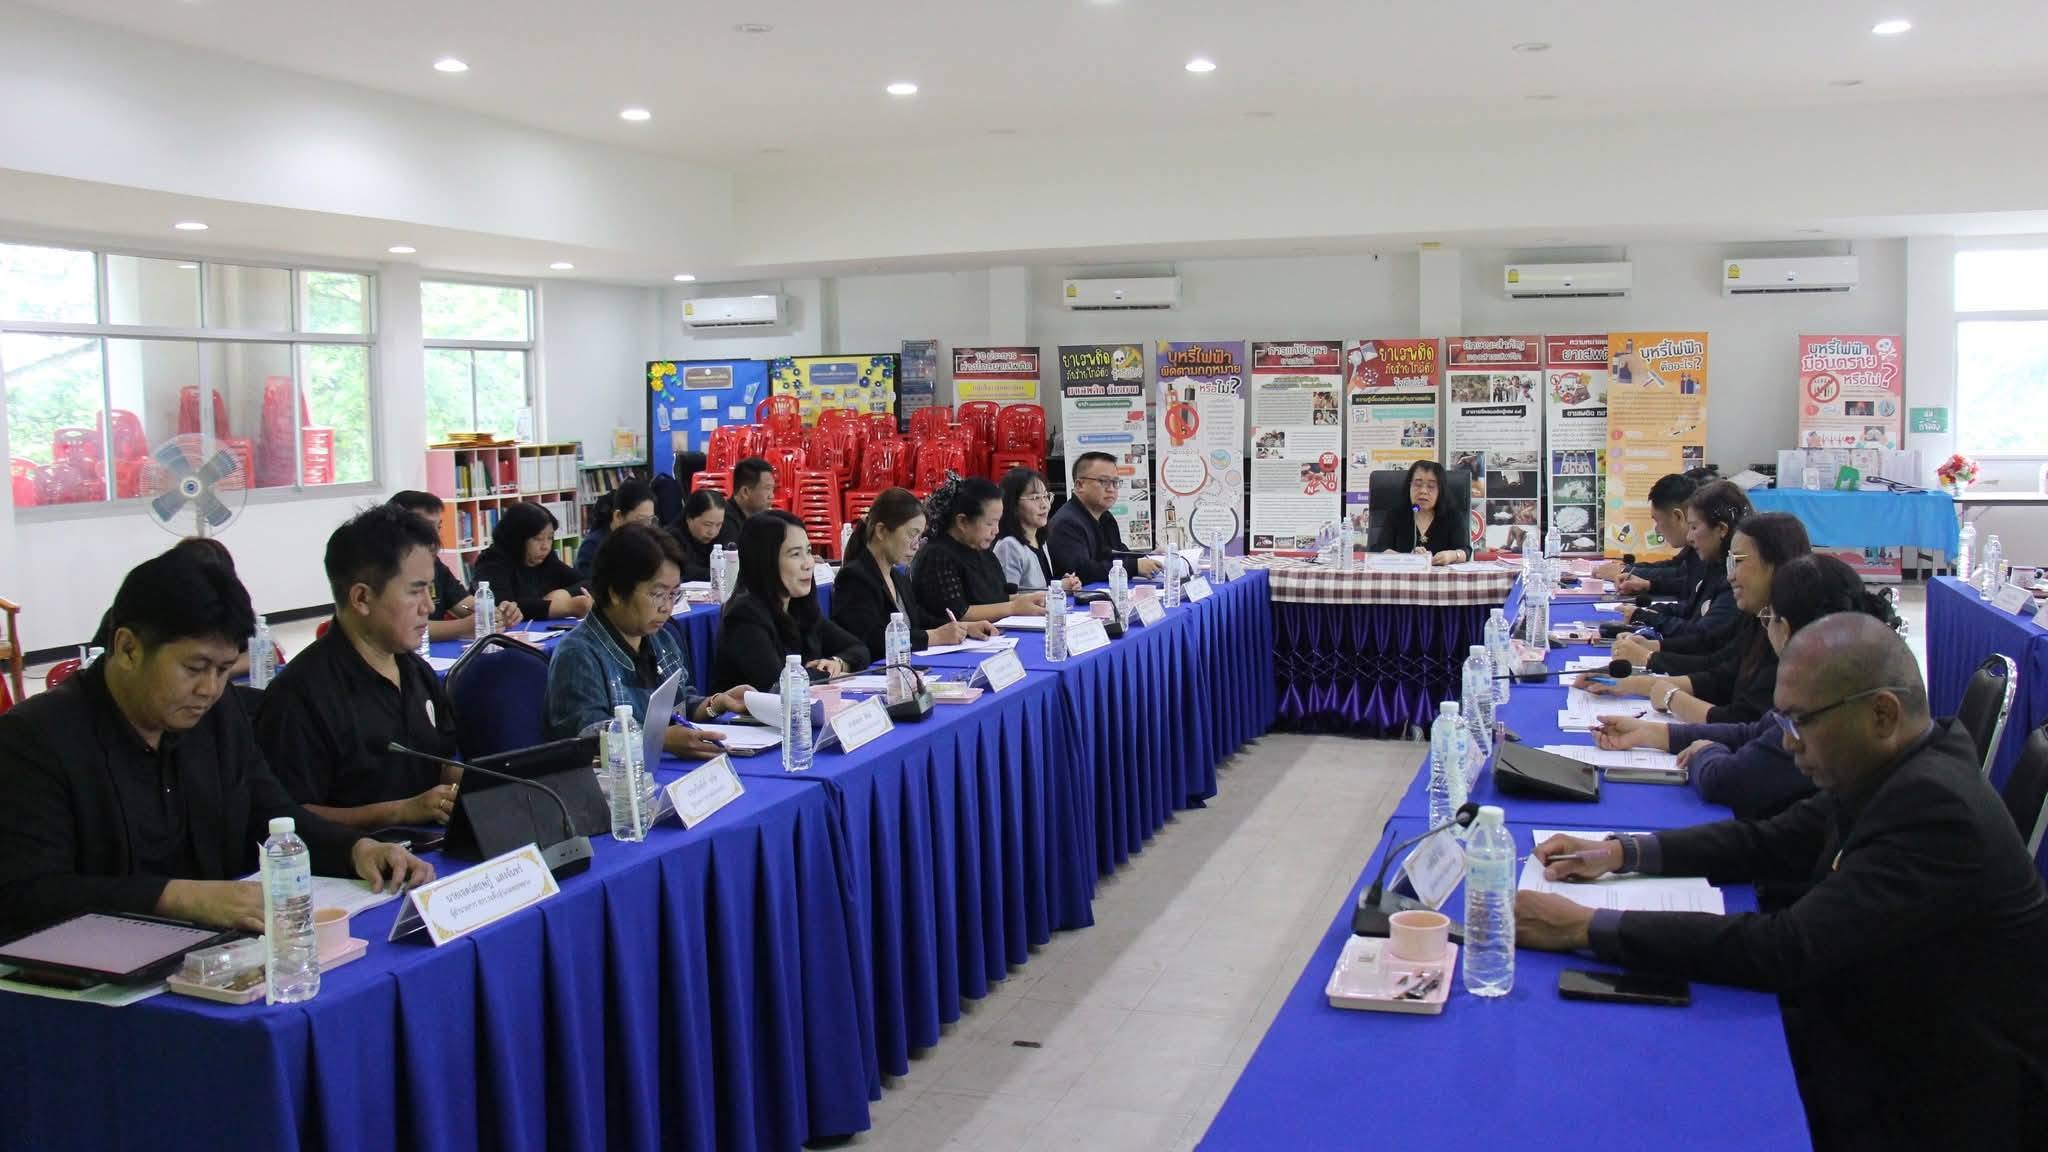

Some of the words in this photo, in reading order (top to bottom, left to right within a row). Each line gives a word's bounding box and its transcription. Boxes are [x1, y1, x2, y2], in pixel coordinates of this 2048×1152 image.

[1168, 345, 1232, 367] บุหรี่ไฟฟ้า
[1641, 339, 1702, 361] บุหรี่ไฟฟ้า
[1810, 339, 1869, 357] บุหรี่ไฟฟ้า
[1161, 363, 1241, 376] ผิดตามกฎหมาย
[1661, 356, 1702, 372] คืออะไร?
[1803, 355, 1876, 371] มีอันตราย
[1844, 363, 1897, 387] หรือไม่?
[1199, 378, 1240, 394] หรือไม่?
